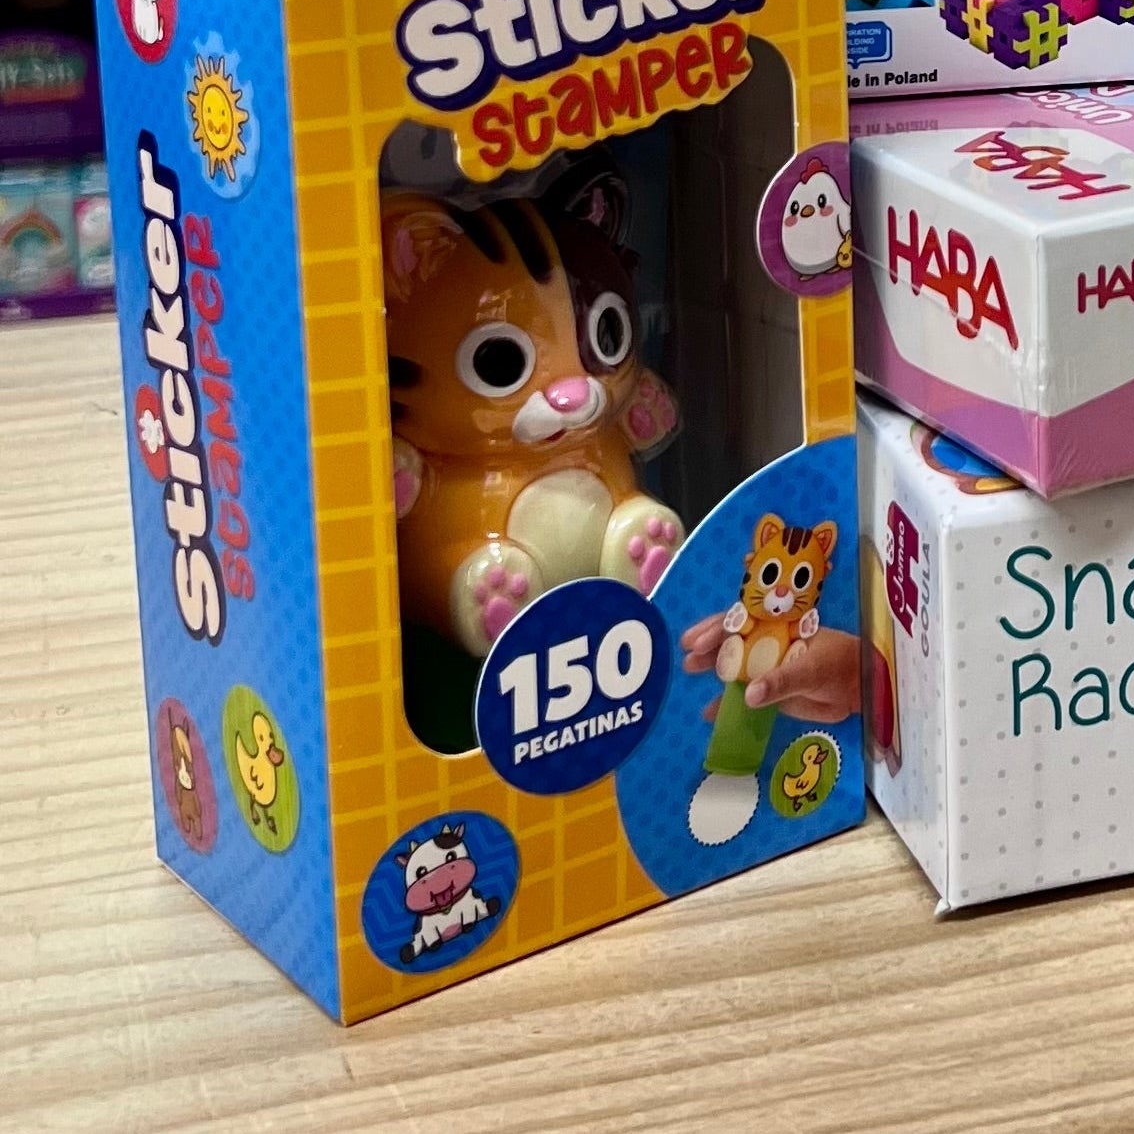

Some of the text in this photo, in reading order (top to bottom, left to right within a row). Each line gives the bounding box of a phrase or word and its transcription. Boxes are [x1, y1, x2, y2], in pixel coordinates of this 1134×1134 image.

[865, 73, 879, 87] in
[885, 69, 938, 86] Poland
[954, 129, 1132, 201] HABA
[886, 205, 1019, 352] HABA
[138, 136, 228, 644] Sticker
[499, 619, 654, 736] 150
[513, 700, 645, 765] PEGATINAS
